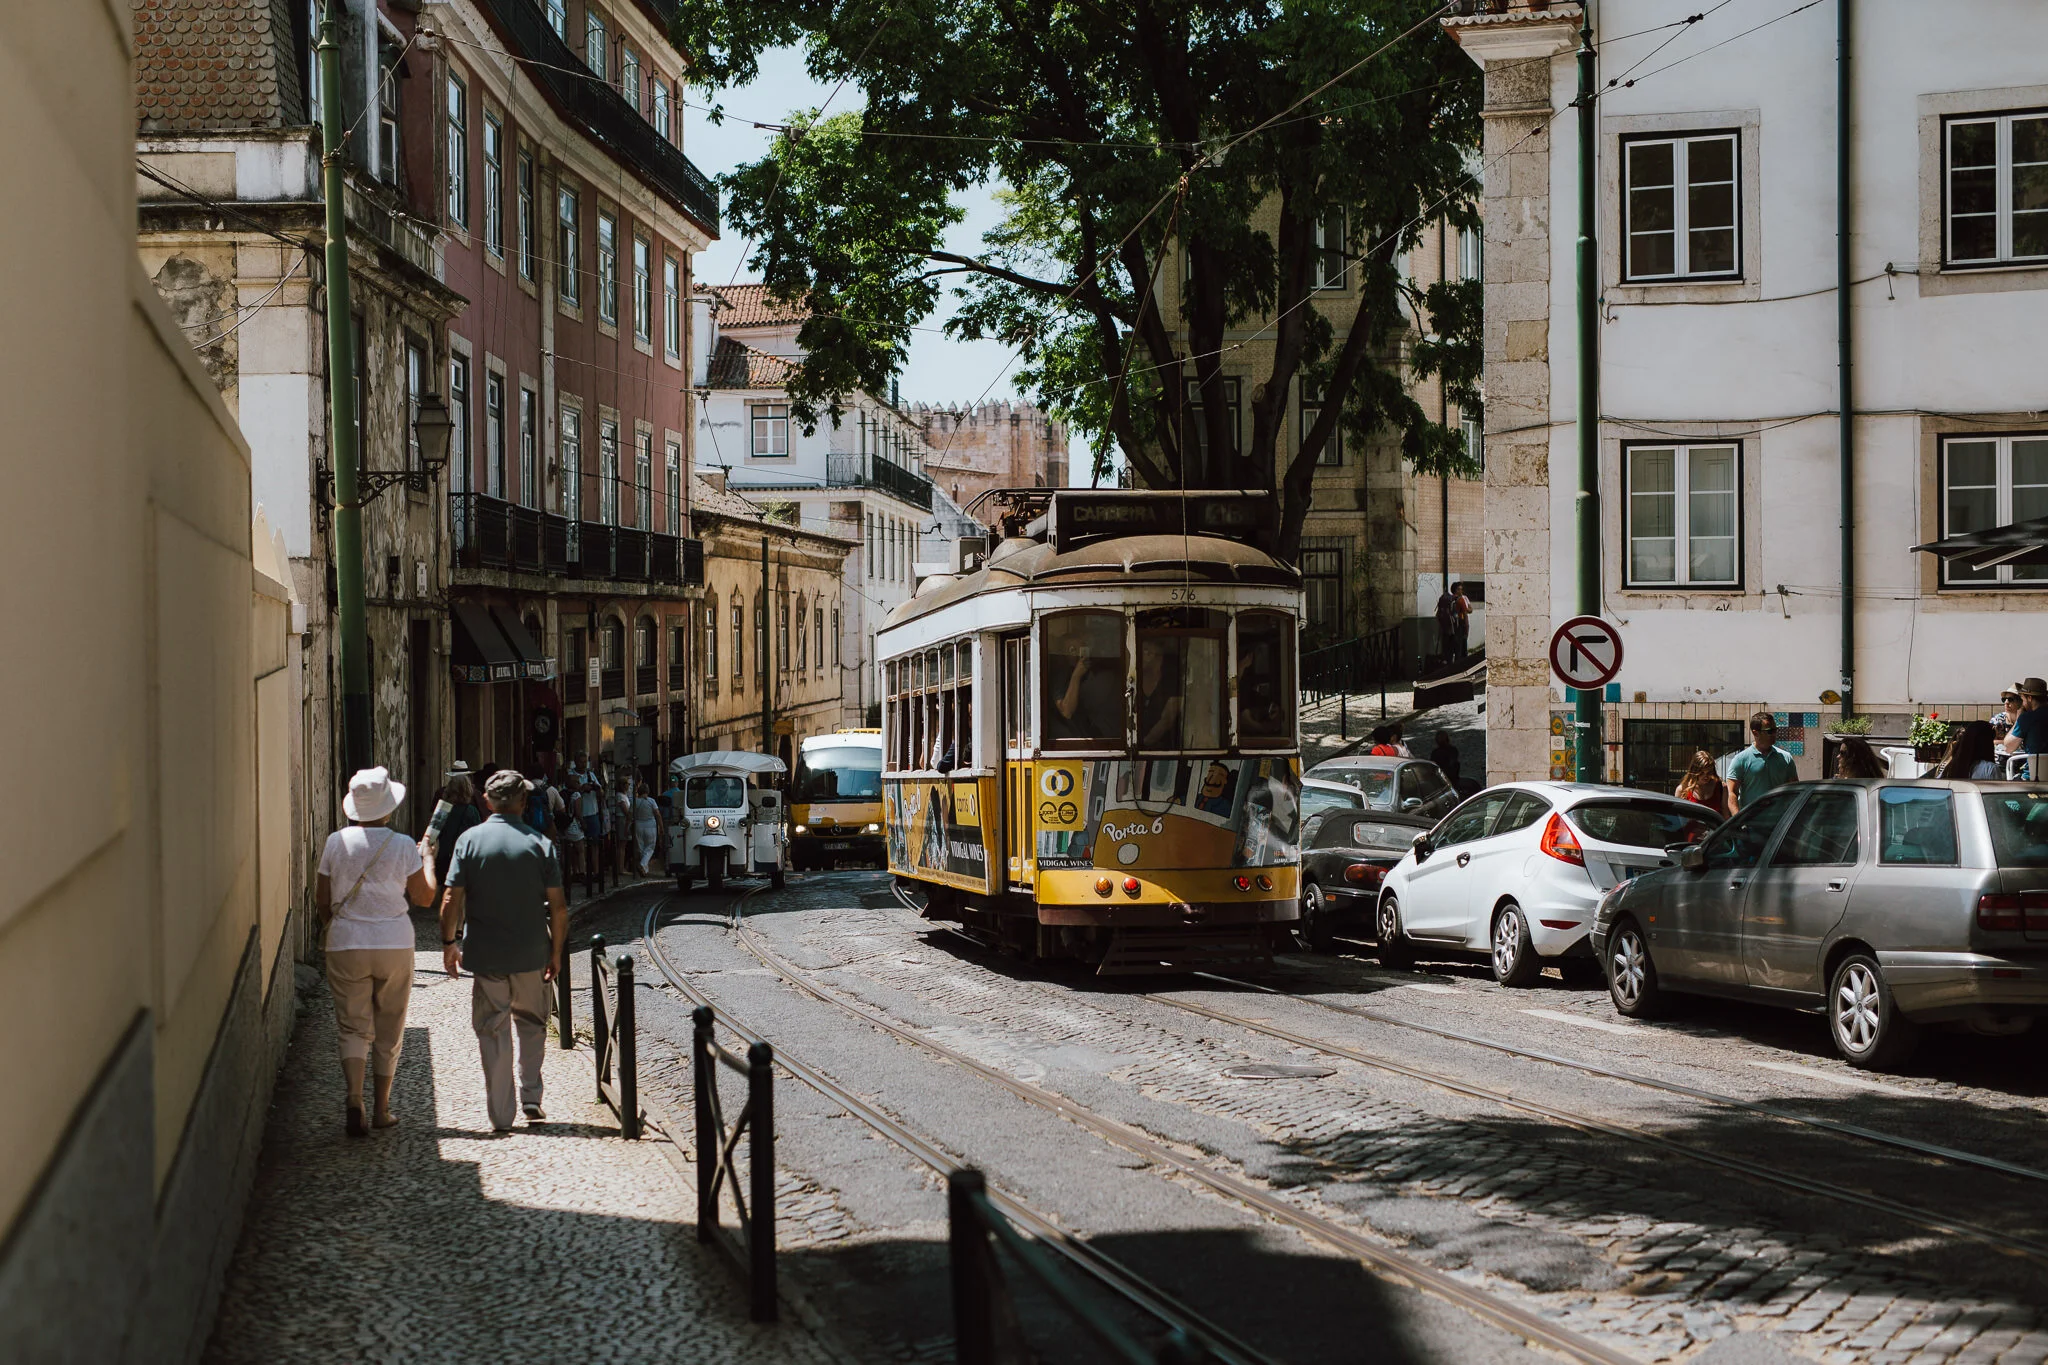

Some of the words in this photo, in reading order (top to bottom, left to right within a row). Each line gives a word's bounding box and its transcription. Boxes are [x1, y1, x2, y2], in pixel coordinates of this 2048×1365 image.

[1171, 588, 1196, 601] 576
[1102, 821, 1149, 842] Porta
[1151, 817, 1163, 834] 6
[951, 841, 969, 860] VIDIGAL
[969, 844, 983, 861] WINES
[1038, 859, 1069, 867] VIDIGAL
[1069, 859, 1094, 867] WINES
